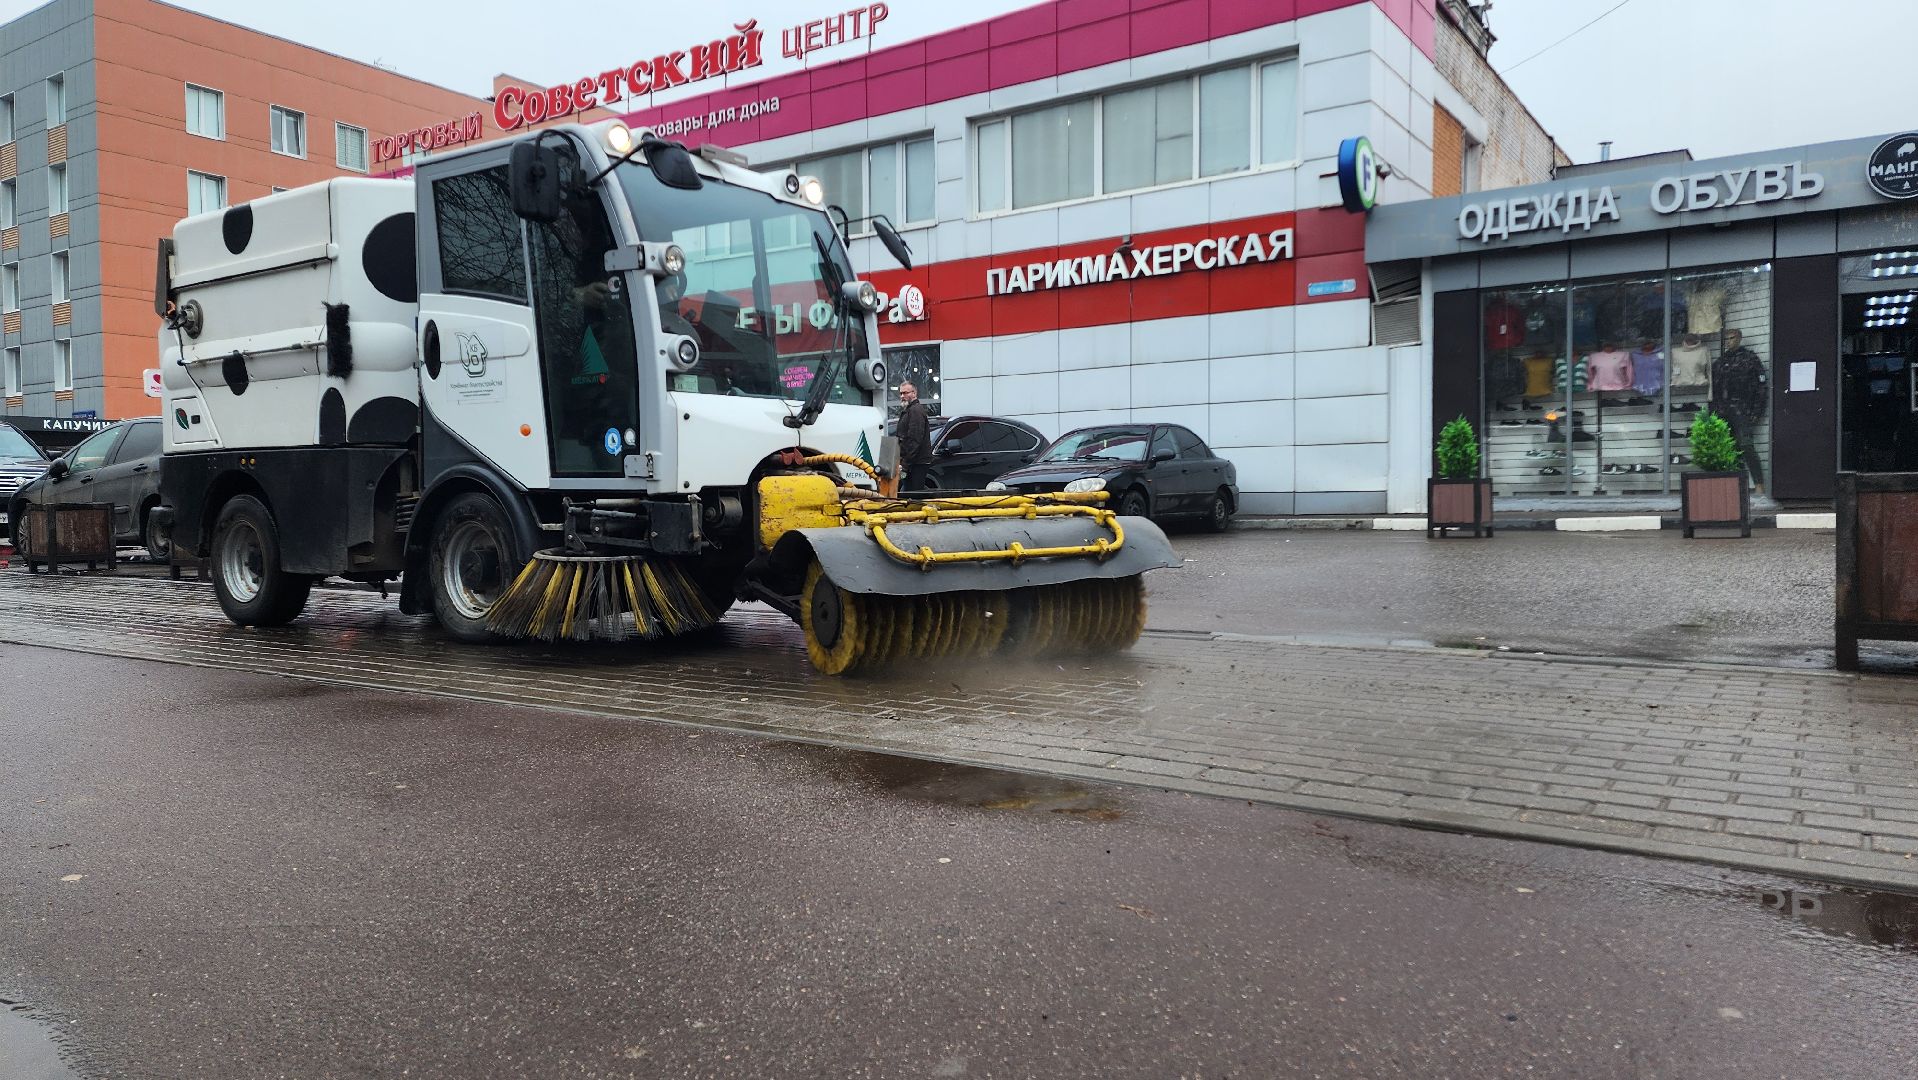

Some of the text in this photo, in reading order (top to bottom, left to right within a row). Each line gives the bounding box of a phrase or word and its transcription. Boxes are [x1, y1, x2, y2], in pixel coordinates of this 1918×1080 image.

[370, 2, 889, 162] ТОРГОВЫЙ Советский ЦЕНТР
[707, 108, 736, 129] для
[740, 96, 781, 121] дома
[1458, 161, 1825, 243] ОДЕЖДА ОБУВЬ
[986, 227, 1294, 297] ПАРИКМАХЕРСКАЯ
[43, 418, 110, 431] КАПУЧИН
